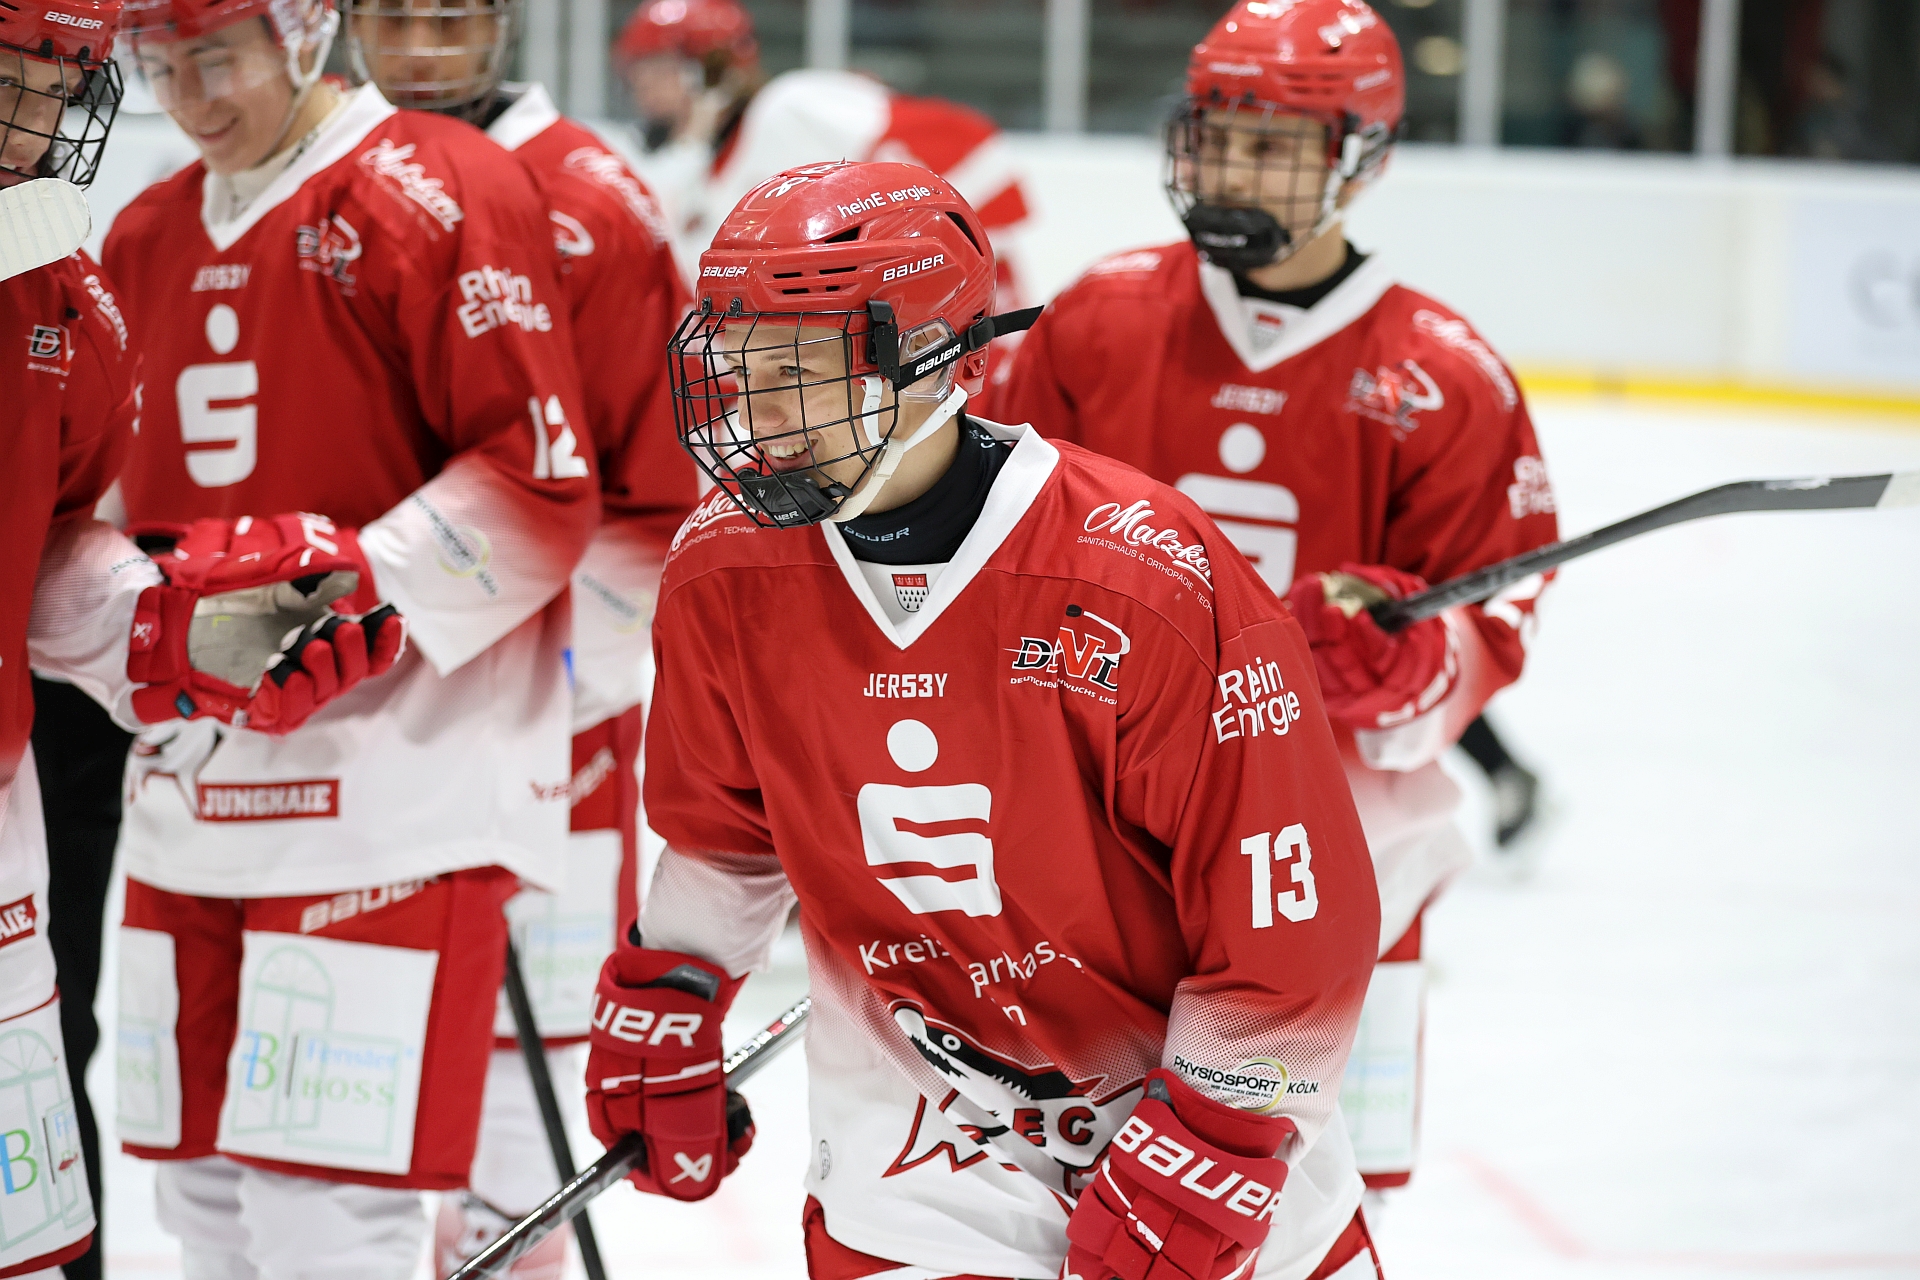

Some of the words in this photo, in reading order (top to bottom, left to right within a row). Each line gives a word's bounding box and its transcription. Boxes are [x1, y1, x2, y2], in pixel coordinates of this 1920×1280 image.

[43, 10, 104, 30] BAUER
[702, 265, 748, 278] BAUER
[882, 253, 945, 282] BAUER
[915, 342, 962, 376] BAUER
[527, 394, 590, 480] 12
[1077, 535, 1137, 558] SANITÄTSHAUS
[1138, 553, 1145, 562] &
[1146, 557, 1194, 591] ORTHOPÄDIE
[863, 673, 949, 699] JER53Y
[1240, 822, 1319, 929] 13
[592, 993, 703, 1047] UER
[1173, 1055, 1280, 1093] PHYSIOSPORT
